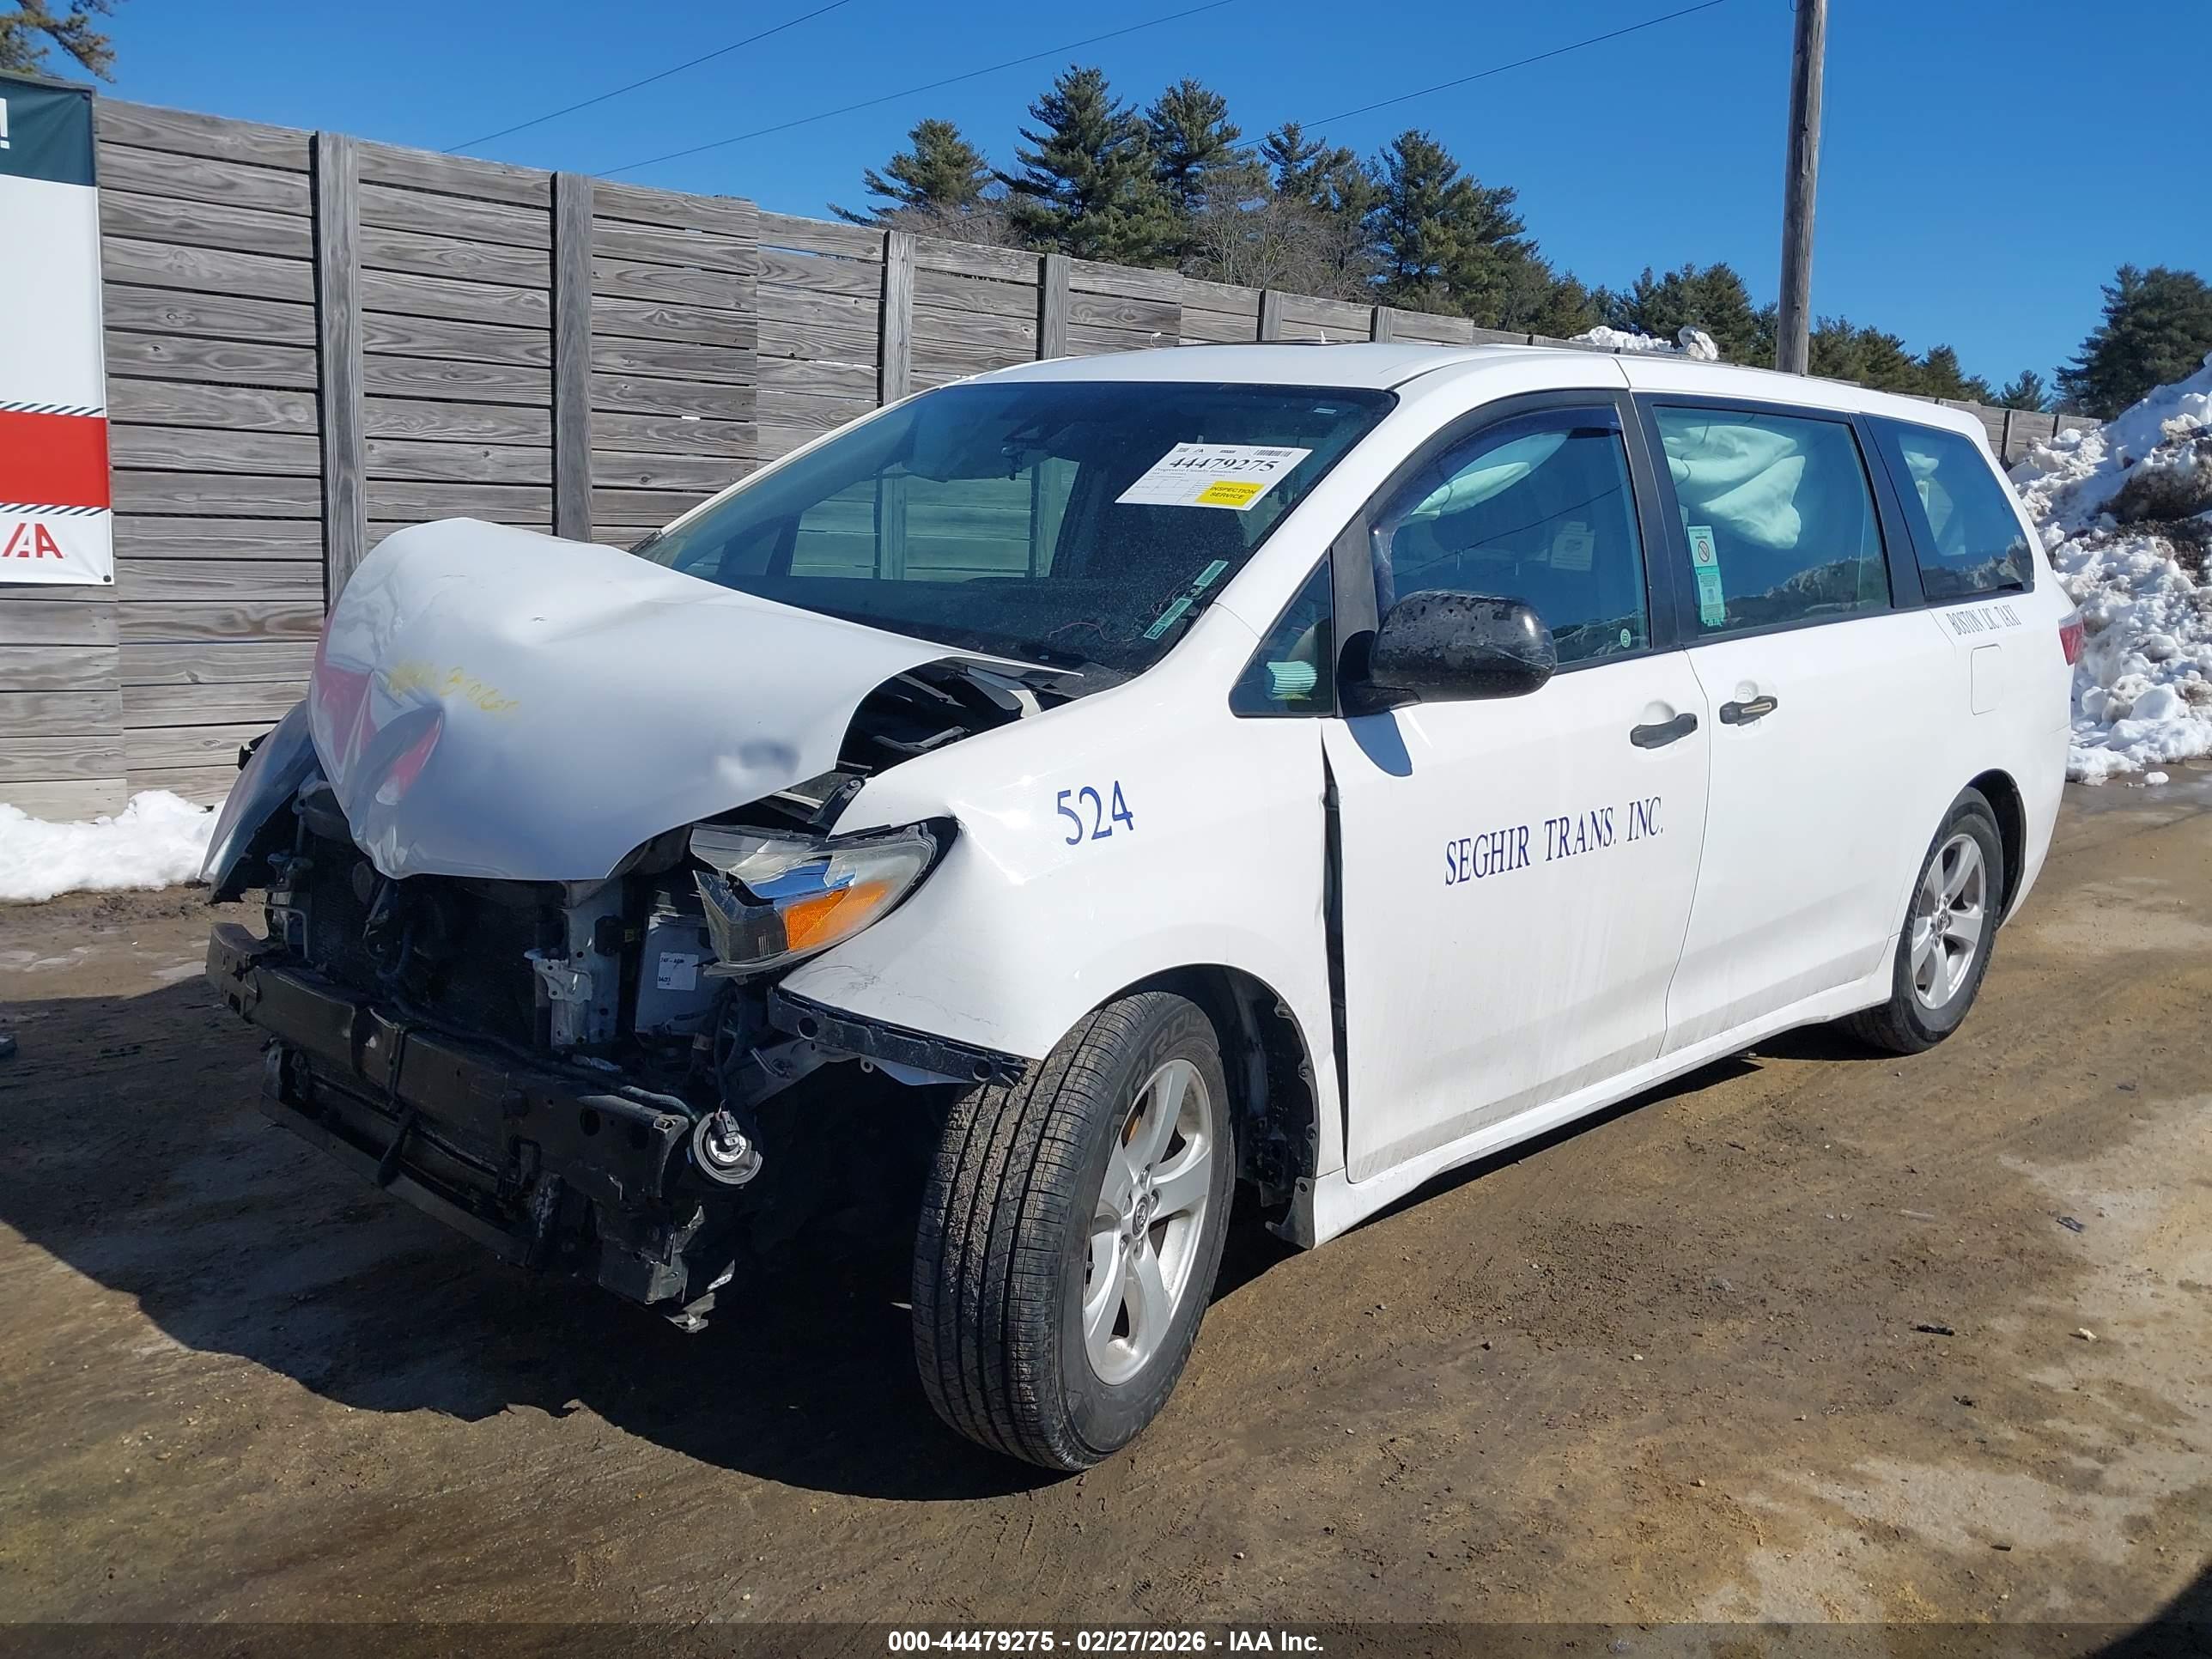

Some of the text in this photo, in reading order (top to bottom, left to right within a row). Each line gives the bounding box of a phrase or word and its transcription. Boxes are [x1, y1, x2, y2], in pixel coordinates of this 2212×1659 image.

[1170, 457, 1279, 471] 44479275
[1209, 486, 1257, 495] INSPECTION
[1946, 610, 1984, 635] BOSTON
[1994, 605, 2021, 627] TAXI
[1057, 780, 1134, 846] 524
[1444, 795, 1664, 887] SEGHIR TRANS. INC.
